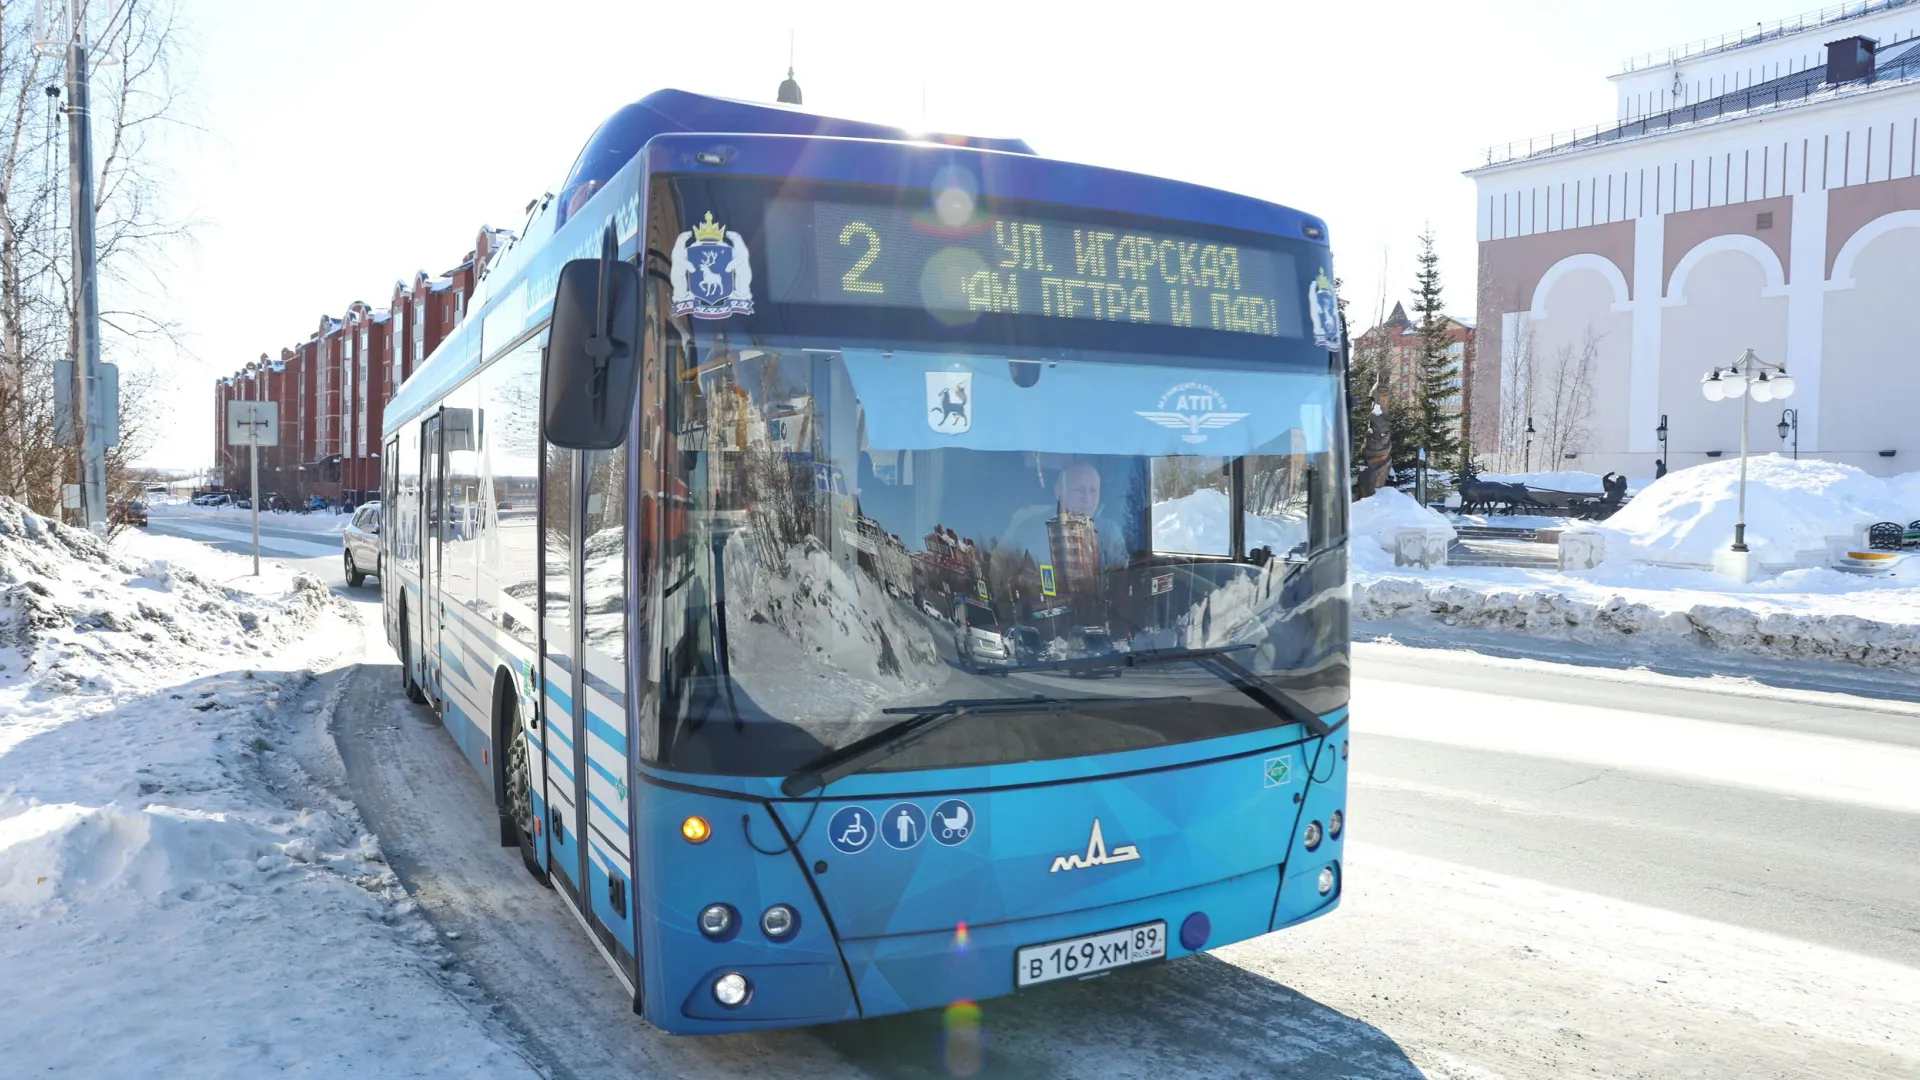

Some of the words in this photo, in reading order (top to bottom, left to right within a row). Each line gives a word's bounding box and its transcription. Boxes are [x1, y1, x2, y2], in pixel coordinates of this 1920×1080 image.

[839, 221, 884, 293] 2
[996, 220, 1054, 272] УЛ.
[1074, 229, 1240, 290] ИГАРСКАЯ
[961, 271, 1019, 315] АМ
[1169, 289, 1192, 328] И
[1176, 395, 1213, 411] АТП
[1135, 927, 1157, 950] 89
